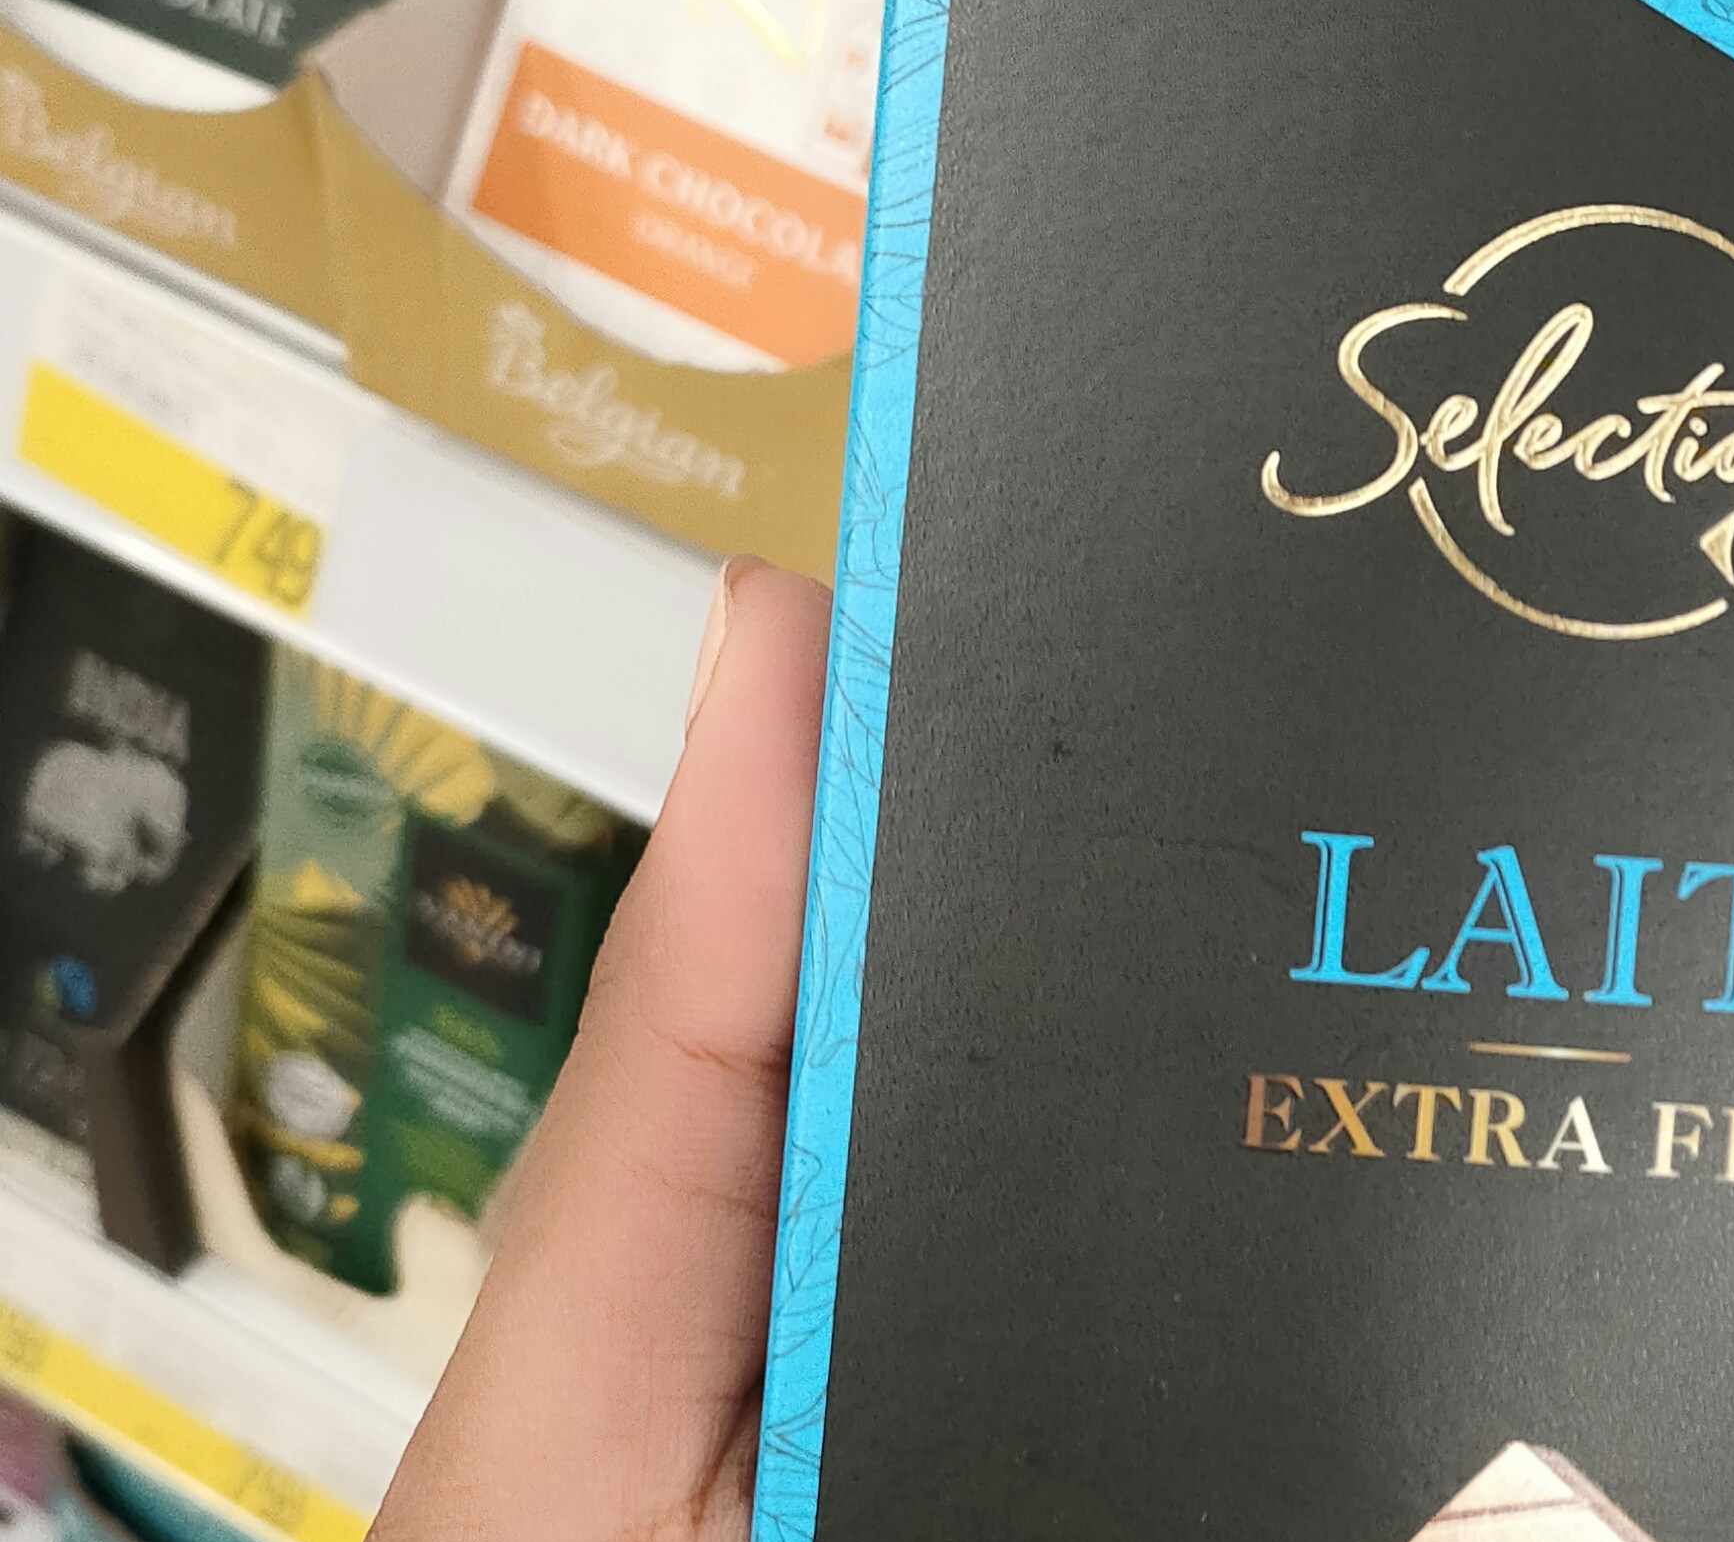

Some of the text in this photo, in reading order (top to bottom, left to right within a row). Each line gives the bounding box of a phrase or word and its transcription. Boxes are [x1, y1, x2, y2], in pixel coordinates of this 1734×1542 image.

[518, 90, 637, 179] DARK
[487, 327, 746, 499] Belgian
[210, 475, 323, 608] 749
[1241, 1073, 1613, 1175] EXTRA
